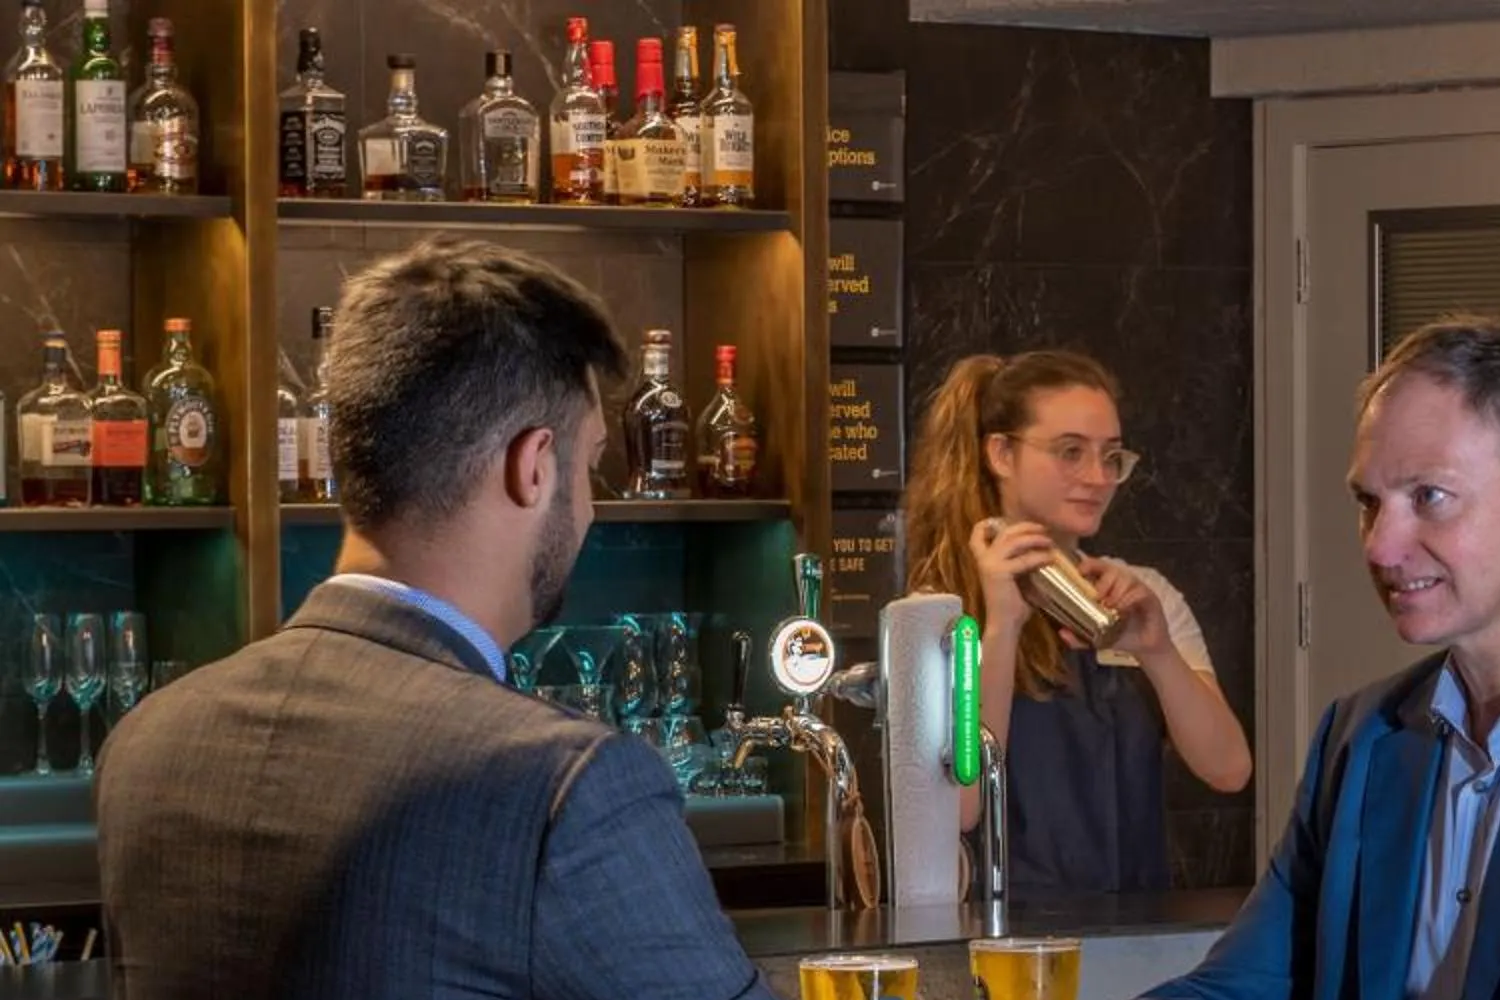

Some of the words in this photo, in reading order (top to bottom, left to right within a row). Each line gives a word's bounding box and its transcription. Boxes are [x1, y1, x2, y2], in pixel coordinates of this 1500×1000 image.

[827, 125, 850, 142] ice
[828, 147, 875, 167] ptions
[828, 275, 869, 293] erved
[830, 400, 871, 418] erved
[845, 421, 877, 439] who
[829, 443, 867, 460] cated
[833, 539, 855, 552] YOU
[858, 539, 872, 552] TO
[874, 539, 894, 552] GET
[839, 558, 865, 571] SAFE
